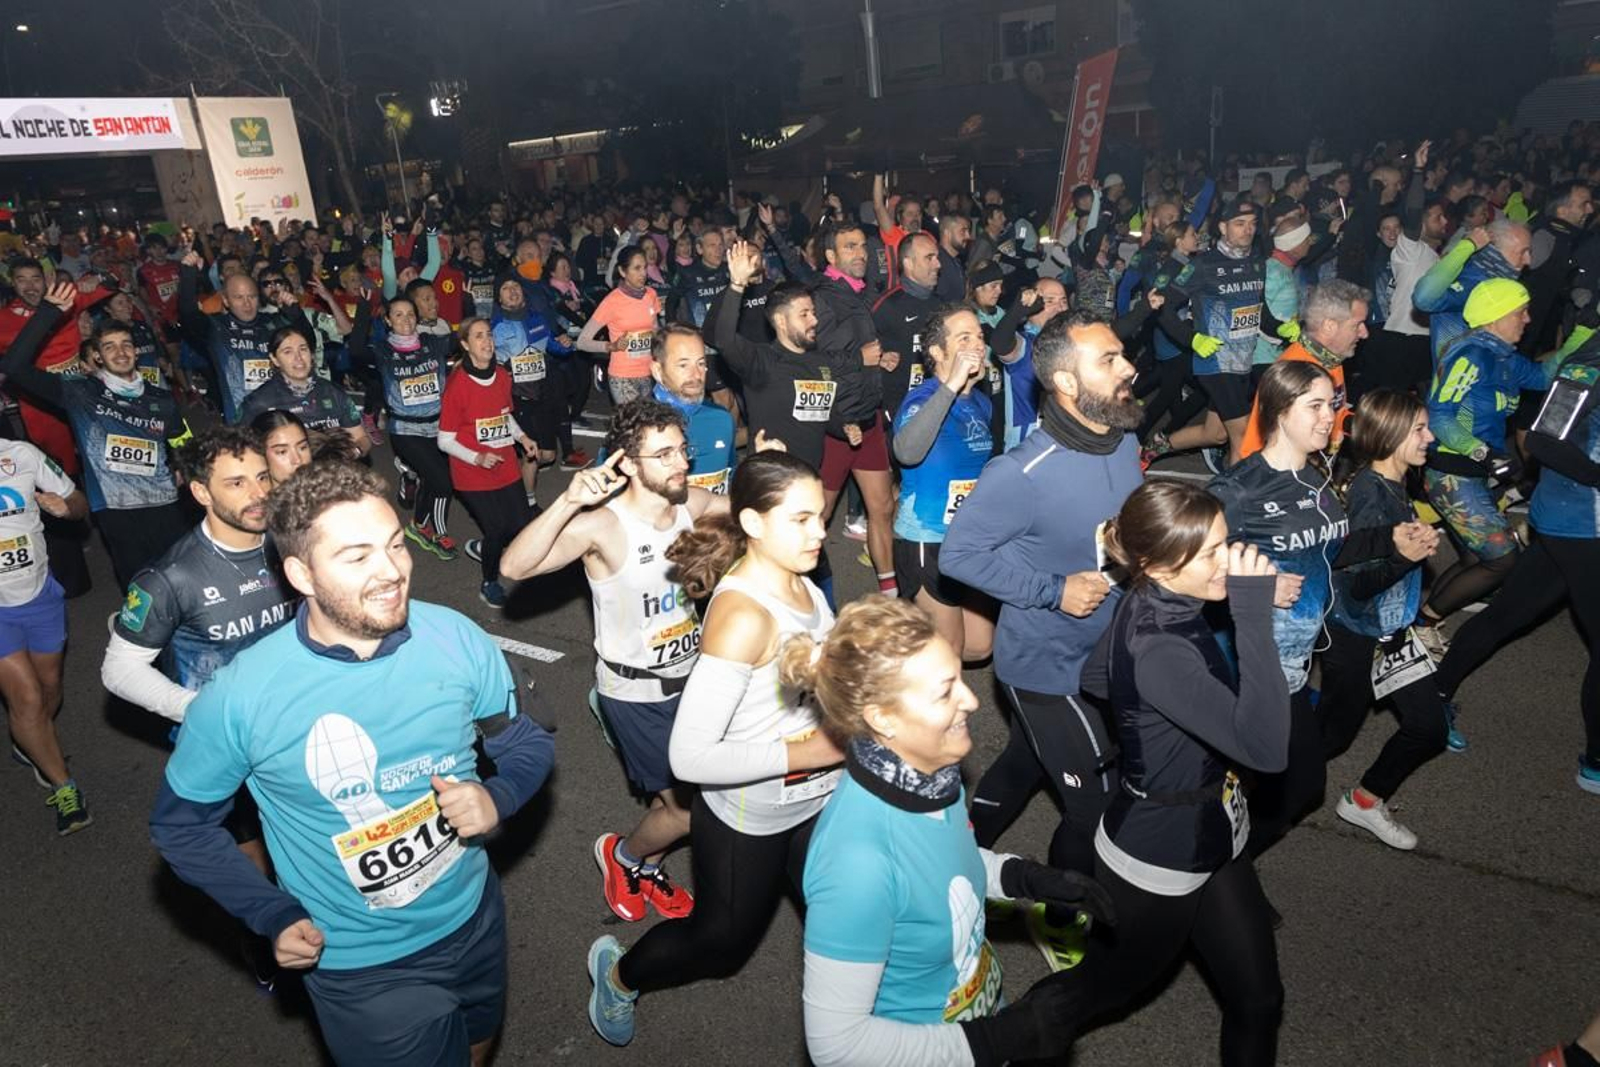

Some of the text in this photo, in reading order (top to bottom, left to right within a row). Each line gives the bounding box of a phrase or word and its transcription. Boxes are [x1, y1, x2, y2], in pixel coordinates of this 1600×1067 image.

[13, 118, 67, 139] NOCHE
[69, 118, 92, 137] DE
[93, 117, 125, 136] SAN
[1218, 284, 1240, 294] SAN
[799, 392, 832, 406] 9079
[480, 424, 510, 438] 9771
[110, 446, 153, 464] 8601
[1272, 528, 1315, 552] SAN
[208, 615, 255, 640] SAN
[653, 627, 701, 663] 7206
[334, 783, 367, 800] 40
[364, 822, 393, 842] 42
